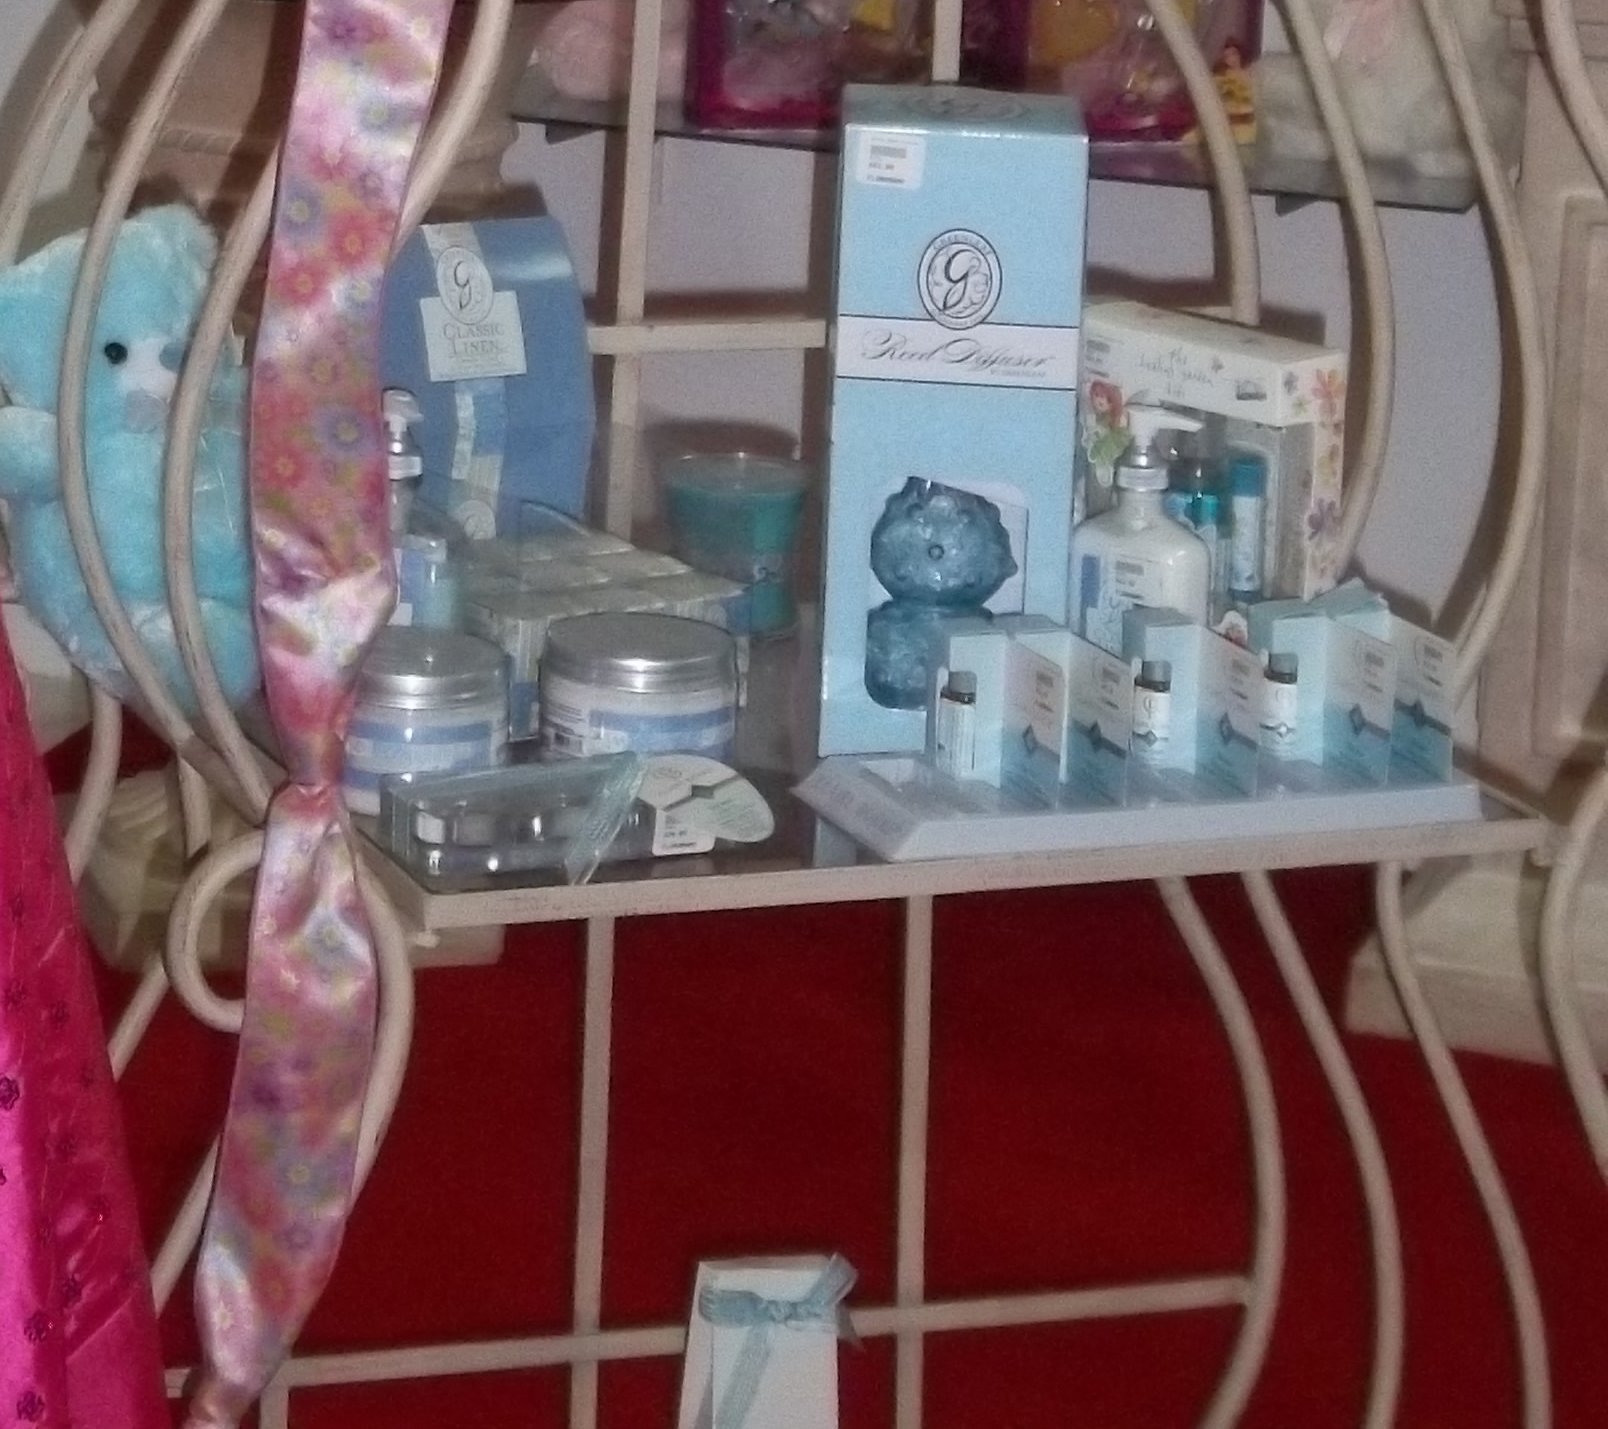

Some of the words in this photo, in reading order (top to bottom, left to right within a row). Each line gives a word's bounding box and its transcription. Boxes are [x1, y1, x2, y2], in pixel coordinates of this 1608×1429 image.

[443, 322, 505, 340] CLASSIC
[449, 338, 501, 358] LINEN
[861, 329, 945, 360] Reed
[943, 337, 1054, 372] Diffuser
